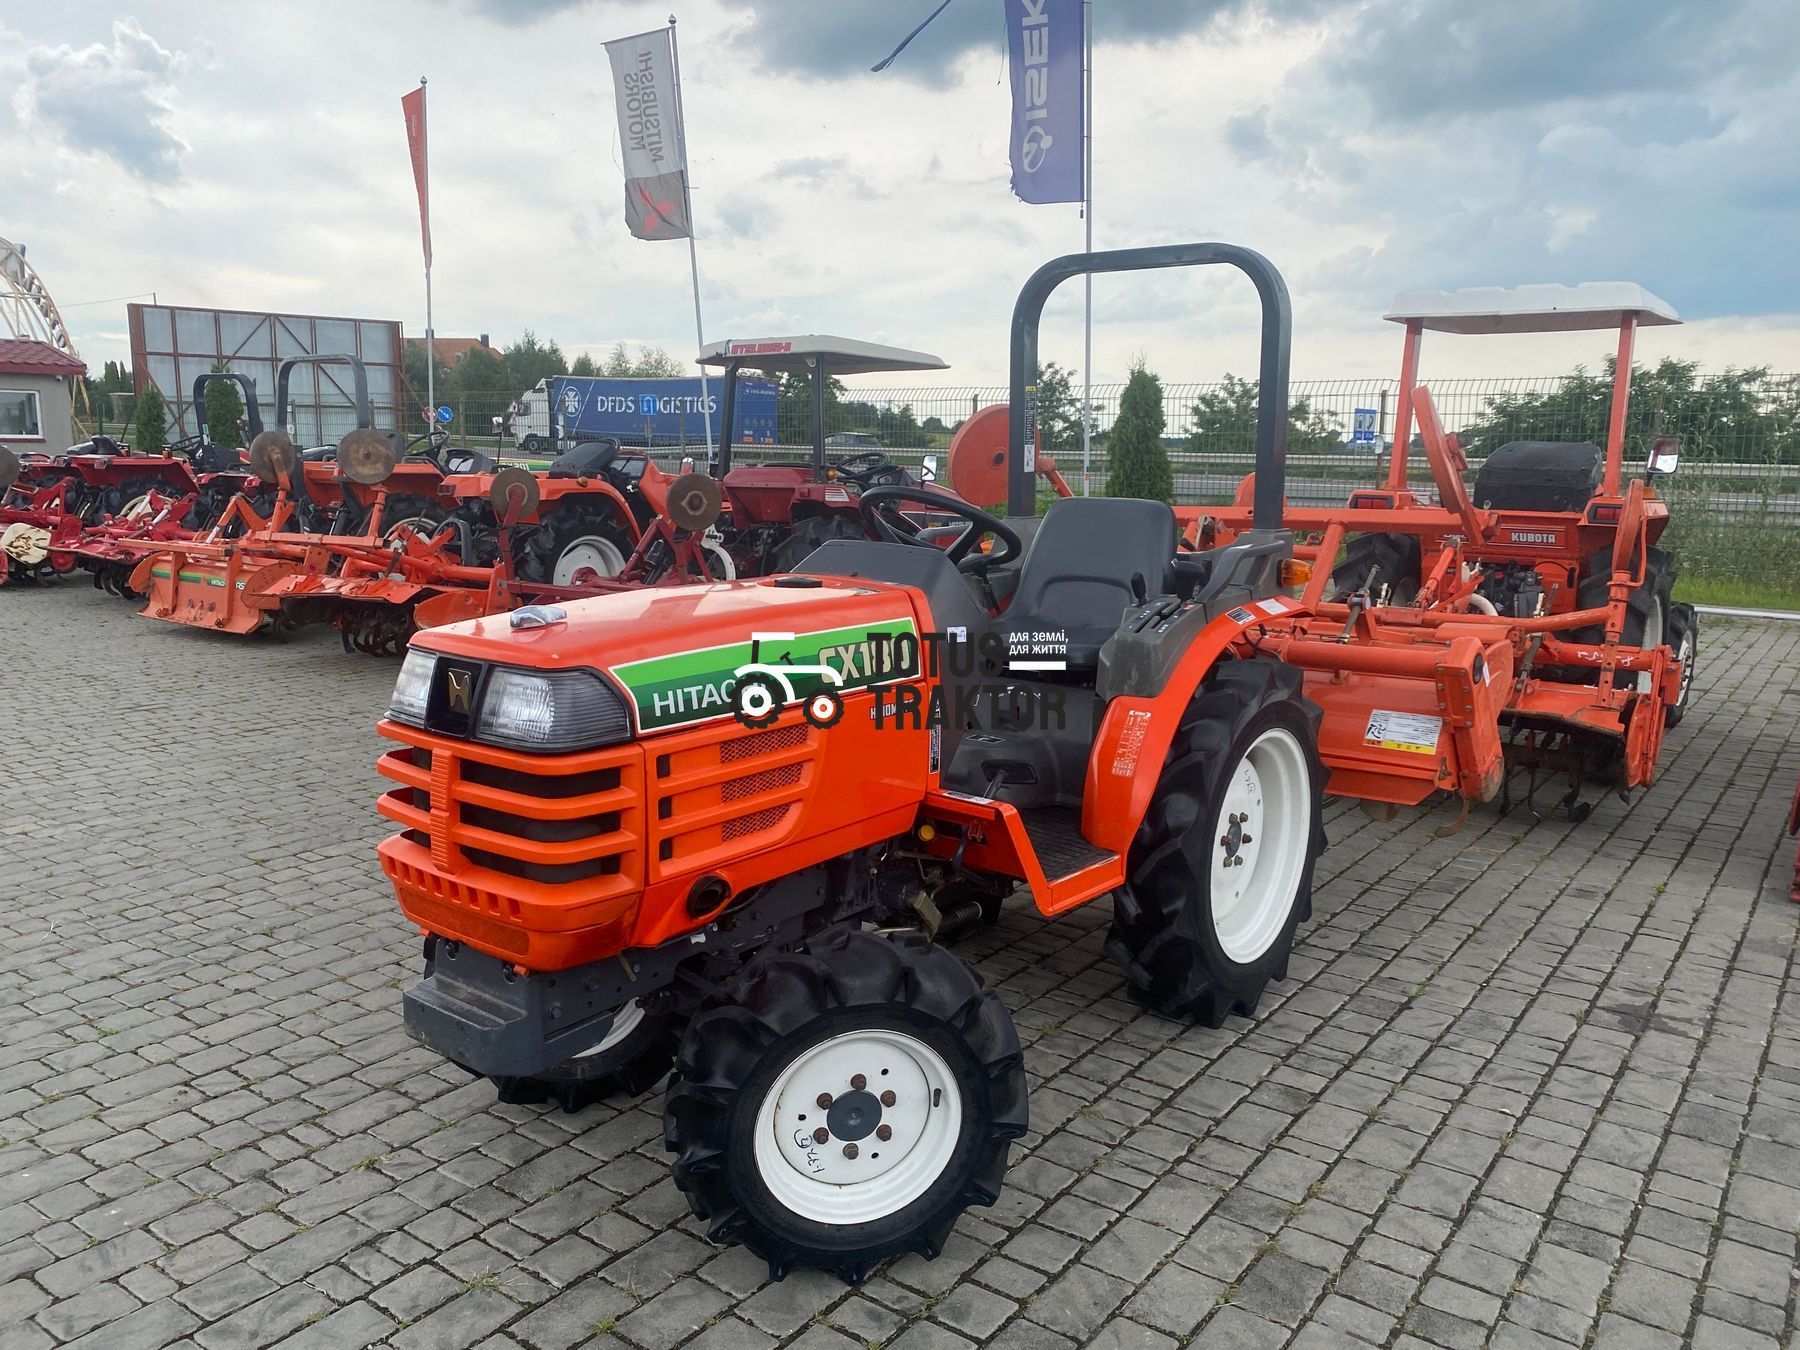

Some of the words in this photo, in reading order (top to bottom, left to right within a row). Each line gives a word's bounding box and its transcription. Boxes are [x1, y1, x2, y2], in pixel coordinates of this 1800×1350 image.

[597, 395, 635, 413] DFDS
[650, 395, 717, 413] GISTICS
[1511, 531, 1556, 544] KUBOTA
[652, 679, 768, 717] HITAC
